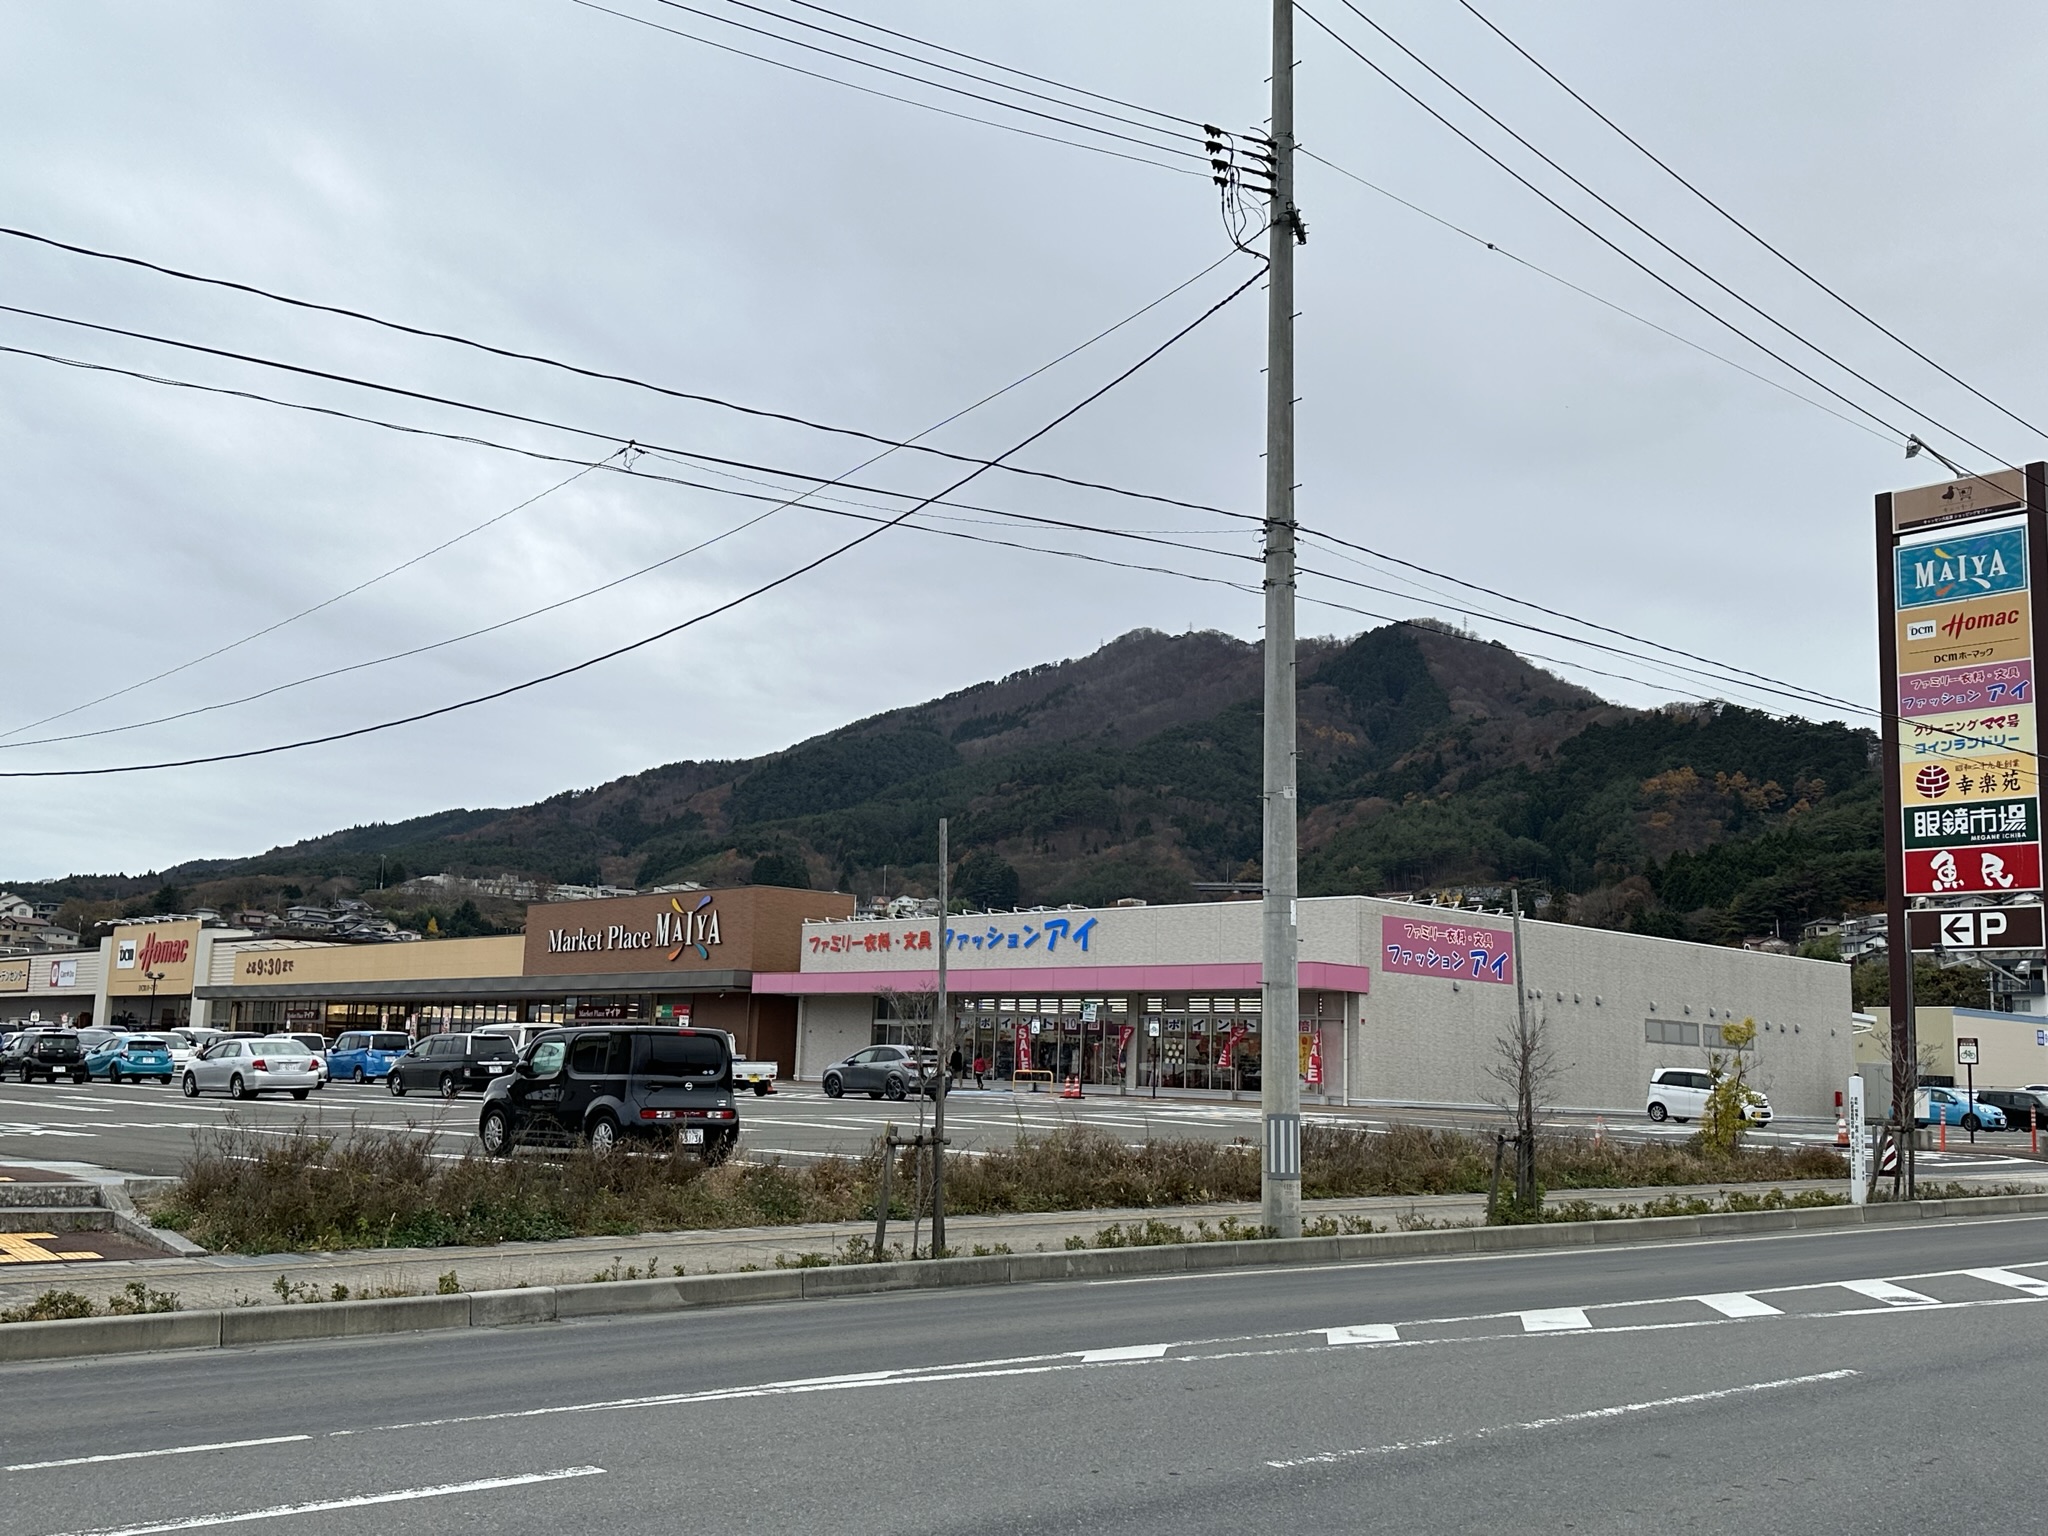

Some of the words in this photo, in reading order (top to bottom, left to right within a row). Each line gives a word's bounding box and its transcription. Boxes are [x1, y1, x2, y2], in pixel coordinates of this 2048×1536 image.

[1915, 549, 2008, 589] MAIYA
[1911, 625, 1934, 636] DCM
[1941, 609, 2020, 640] Homac
[1910, 665, 2020, 690] ファミリー衣料・文具
[1915, 734, 2020, 755] コインランドリー
[1955, 771, 2021, 796] 幸楽苑
[1914, 804, 2026, 838] 眼鏡市場
[1930, 850, 2014, 892] 魚民
[547, 925, 605, 953] Market
[608, 924, 652, 950] Place
[655, 910, 722, 947] MAIYA
[808, 930, 932, 953] ファミリー衣料・文具
[1404, 923, 1494, 949] ファミリー衣料・文具
[1980, 912, 2007, 945] P
[138, 931, 189, 973] Homac
[1307, 1033, 1320, 1081] SALE
